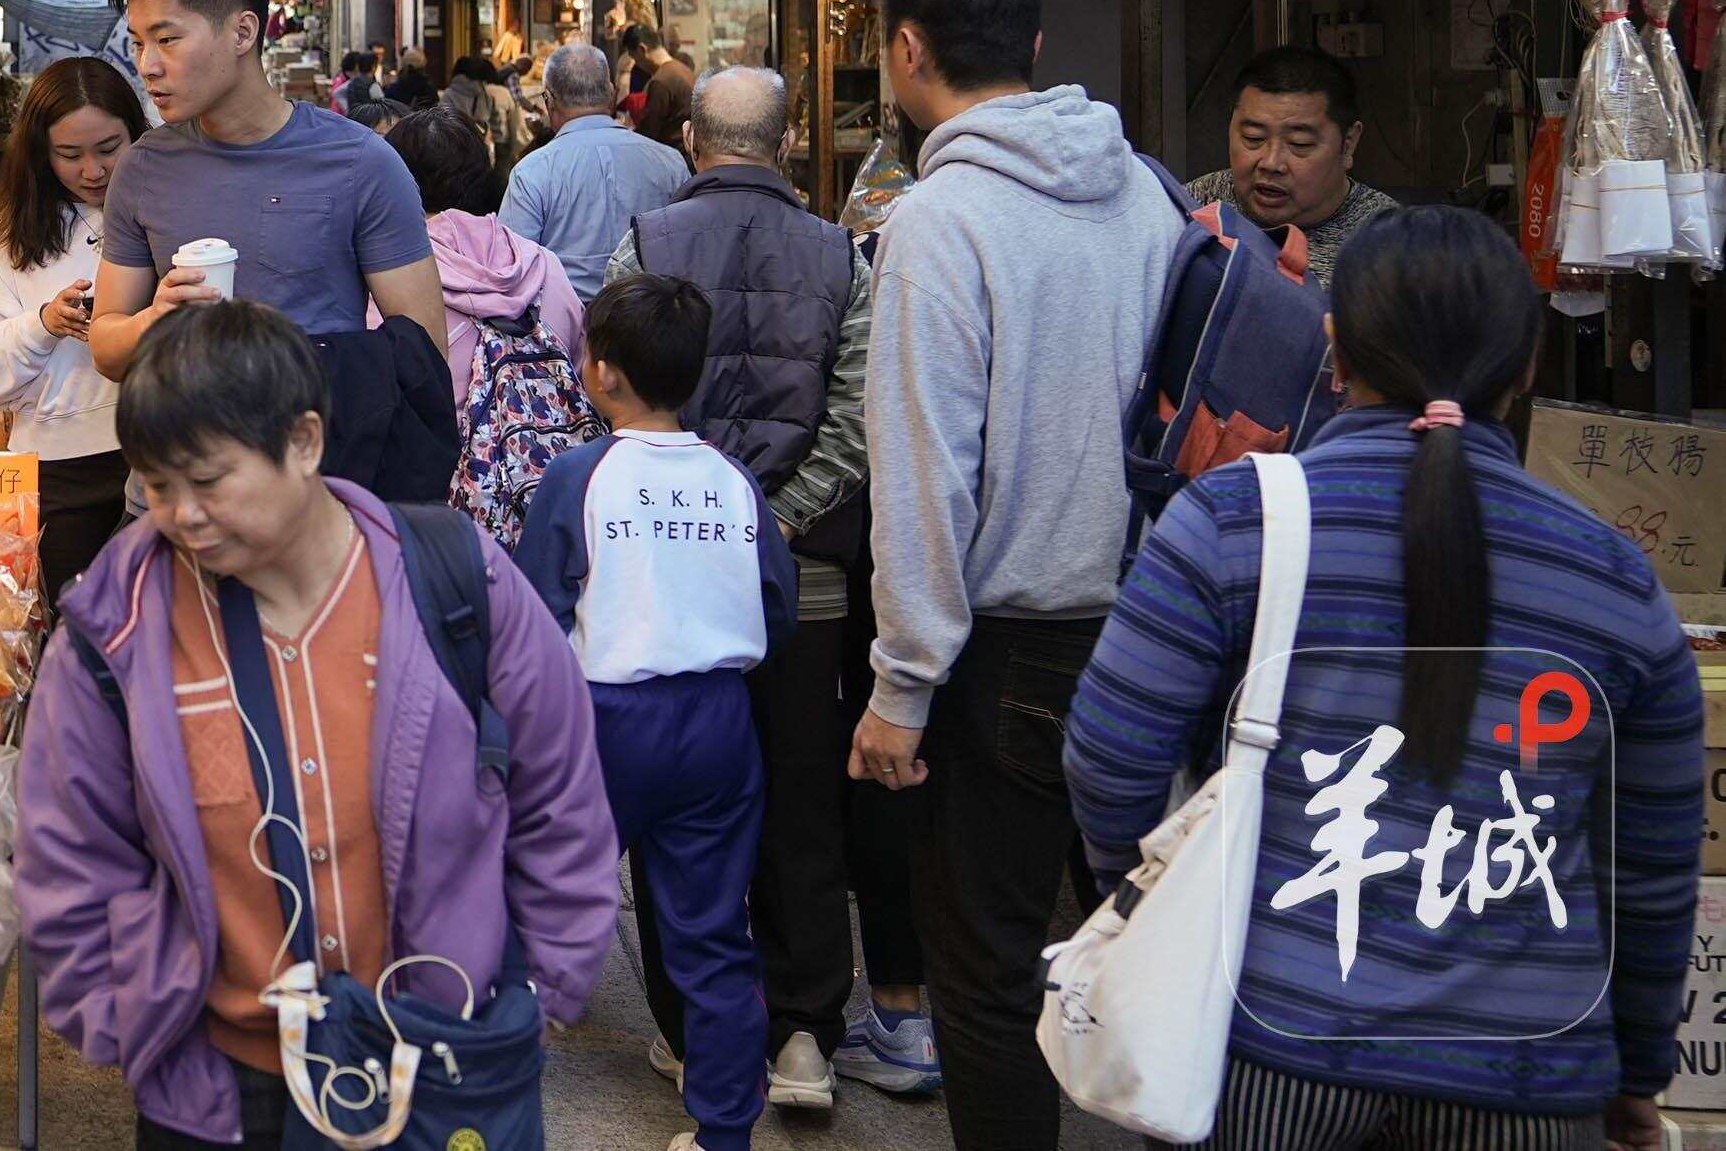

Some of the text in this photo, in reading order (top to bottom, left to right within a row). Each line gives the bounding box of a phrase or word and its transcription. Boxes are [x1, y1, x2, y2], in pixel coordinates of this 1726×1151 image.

[1528, 182, 1544, 238] 2080
[639, 488, 724, 509] S. K. H.
[606, 521, 757, 544] ST. PETER'S
